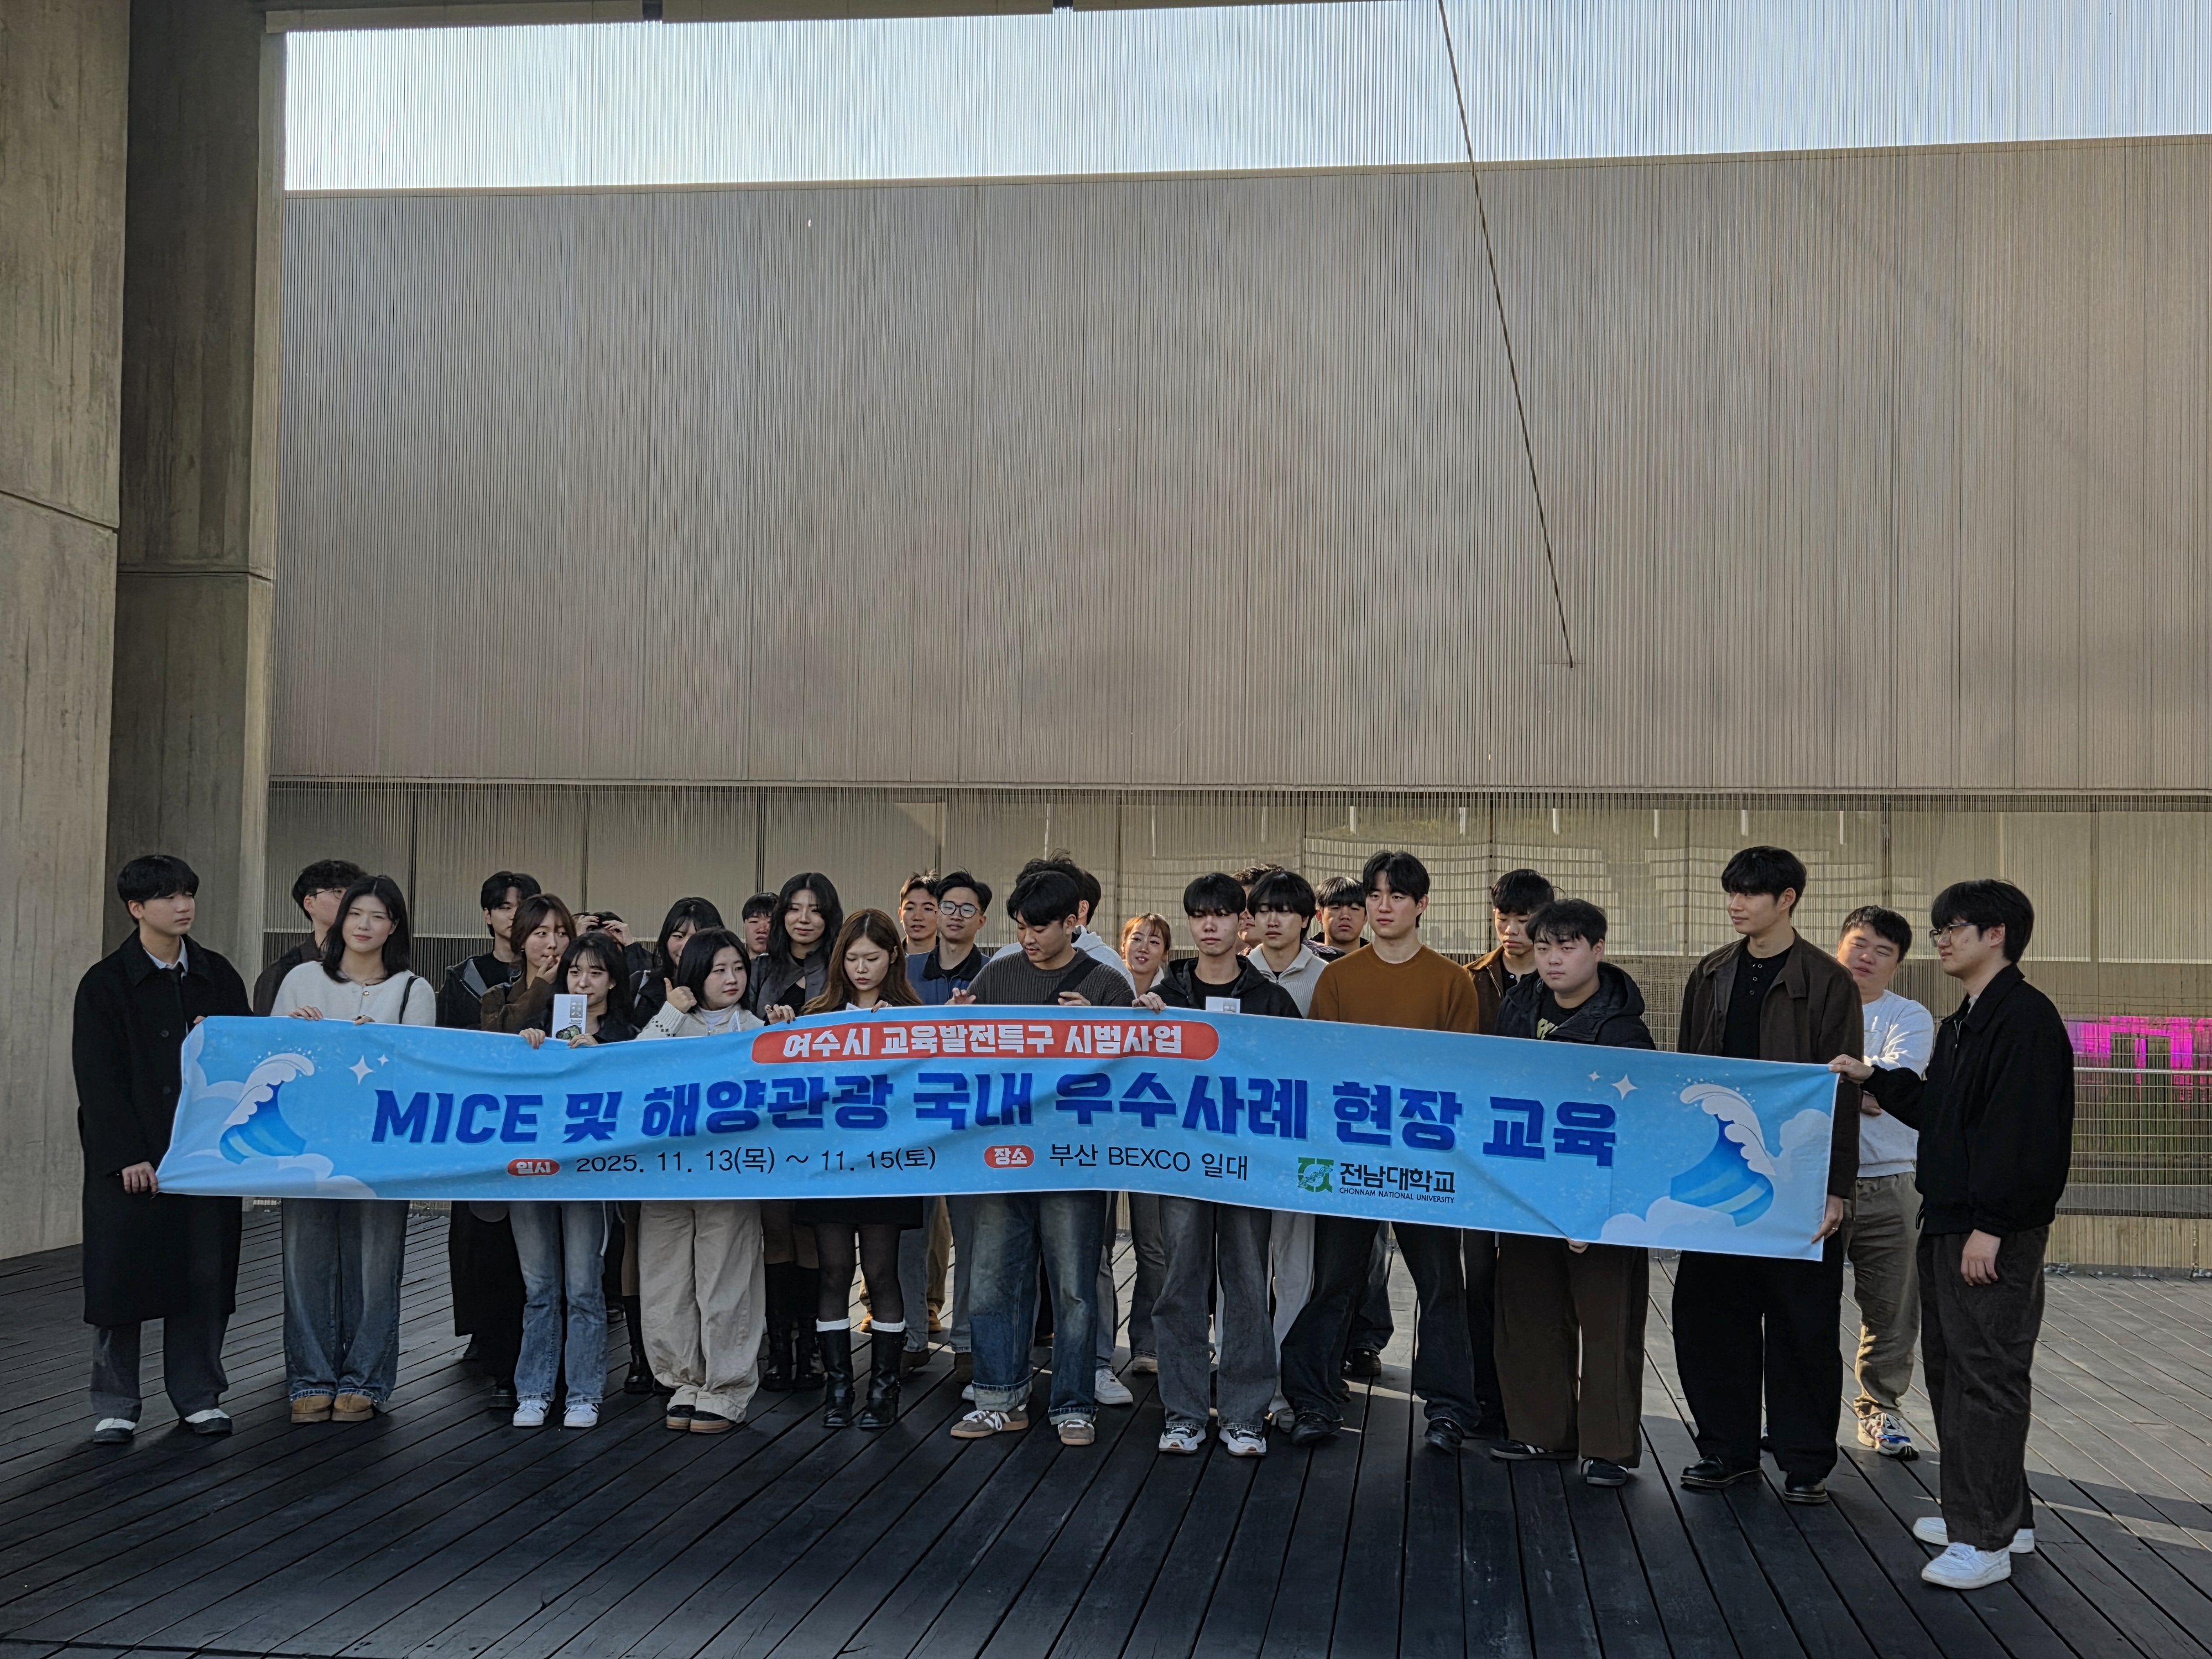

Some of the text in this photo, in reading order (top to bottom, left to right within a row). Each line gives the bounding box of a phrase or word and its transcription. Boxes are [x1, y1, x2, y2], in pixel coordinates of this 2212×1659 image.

[782, 1024, 1182, 1057] 여수시 교육발전특구 시범사업
[371, 1072, 1616, 1167] MICE 및 해양관광 국내 우수사례 현장 교육
[516, 1161, 551, 1174] 일시
[576, 1154, 645, 1173] 2025.
[657, 1151, 692, 1173] 11.
[705, 1146, 775, 1174] 13(목)
[821, 1150, 855, 1171] 11.
[867, 1146, 936, 1171] 15(토)
[993, 1144, 1248, 1181] 장소 부산 BEXCO 일대
[1339, 1162, 1455, 1193] 전남대학교
[1339, 1187, 1454, 1203] CHONNAM NATIONAL UNIVERSITY
